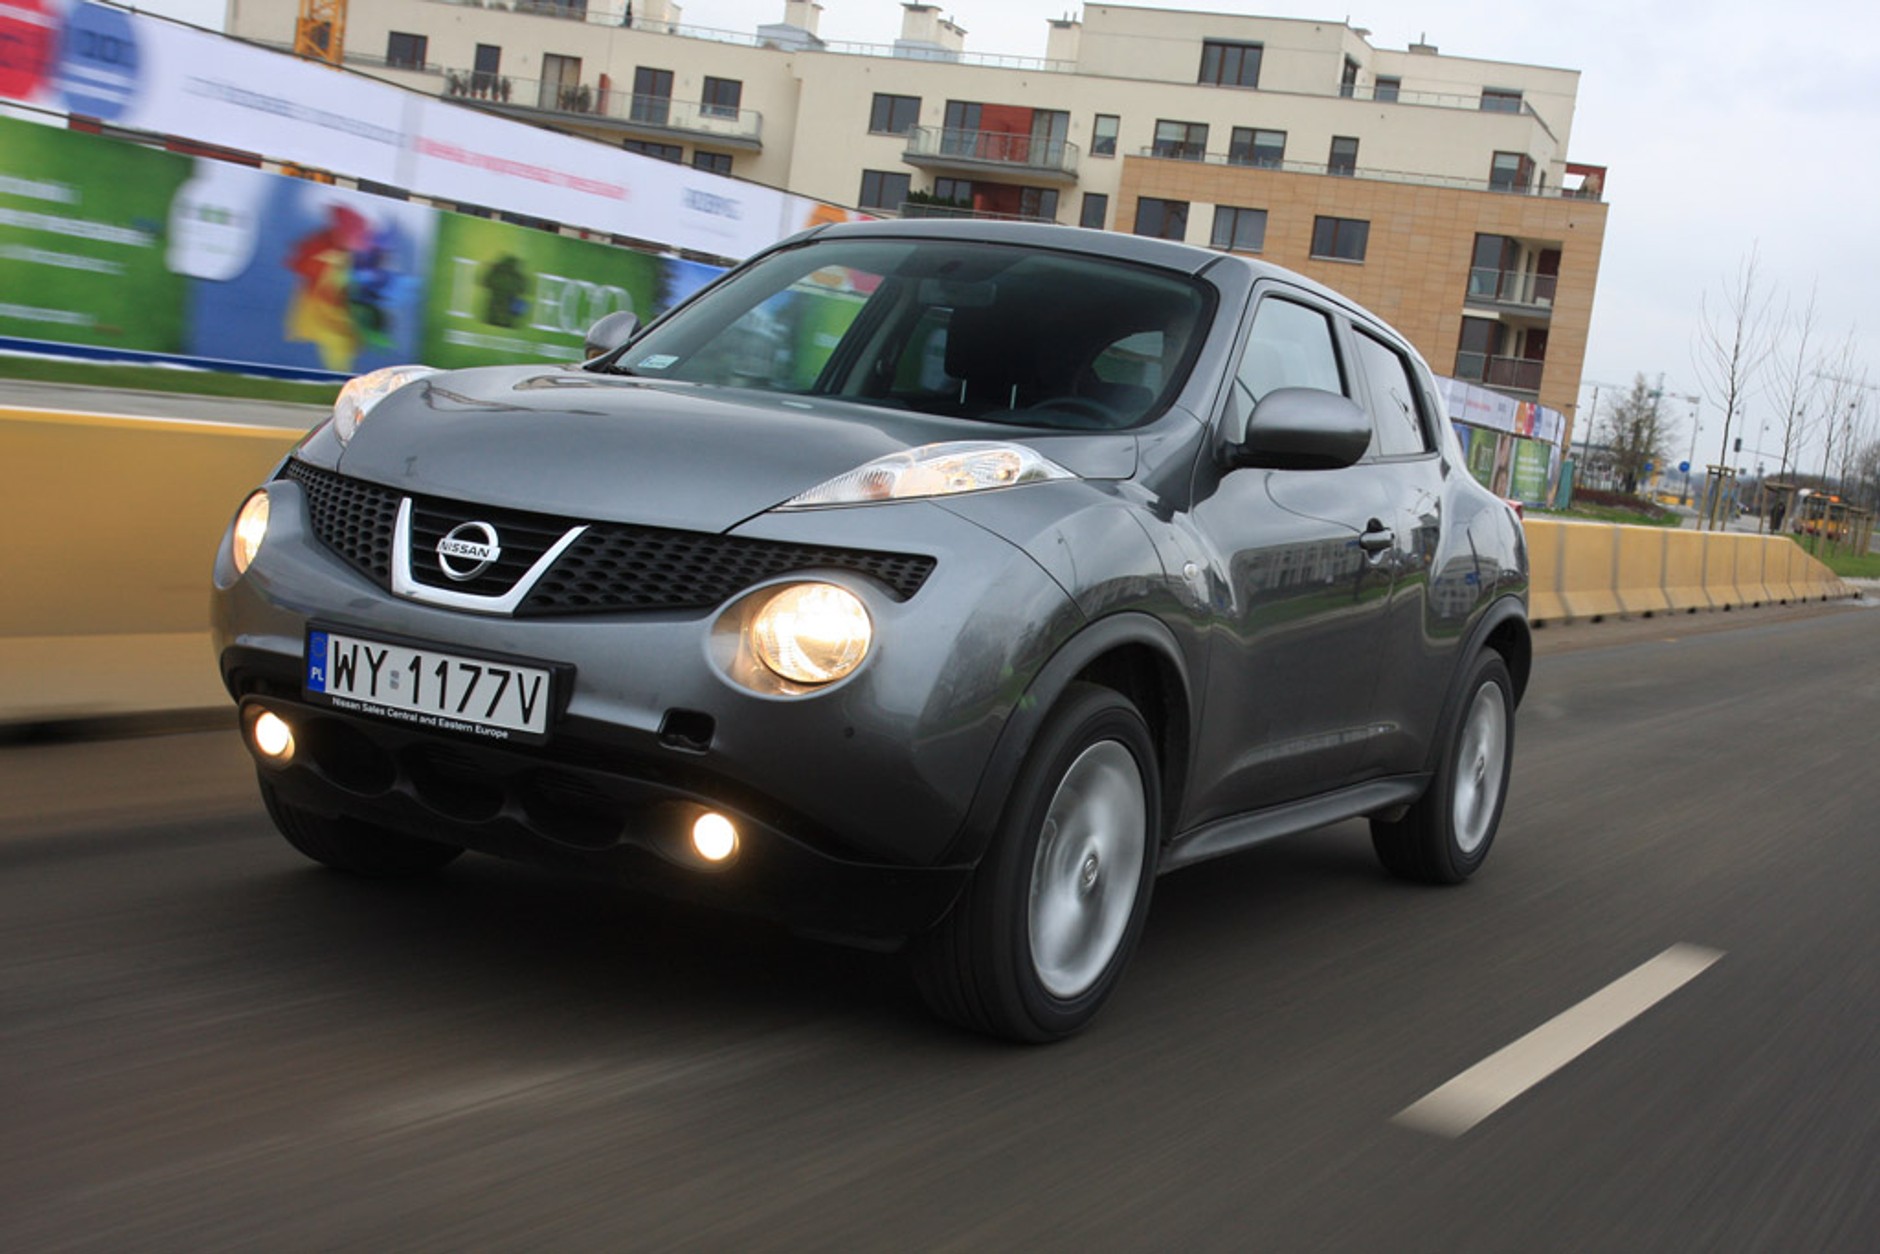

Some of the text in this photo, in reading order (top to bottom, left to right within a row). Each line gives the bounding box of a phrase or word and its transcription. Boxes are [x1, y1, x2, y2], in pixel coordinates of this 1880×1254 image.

[440, 540, 490, 558] NISSAN
[311, 666, 324, 682] PL
[334, 640, 542, 725] WY 1177V
[332, 697, 508, 739] Nissan Sales Central and Eastern Europe
